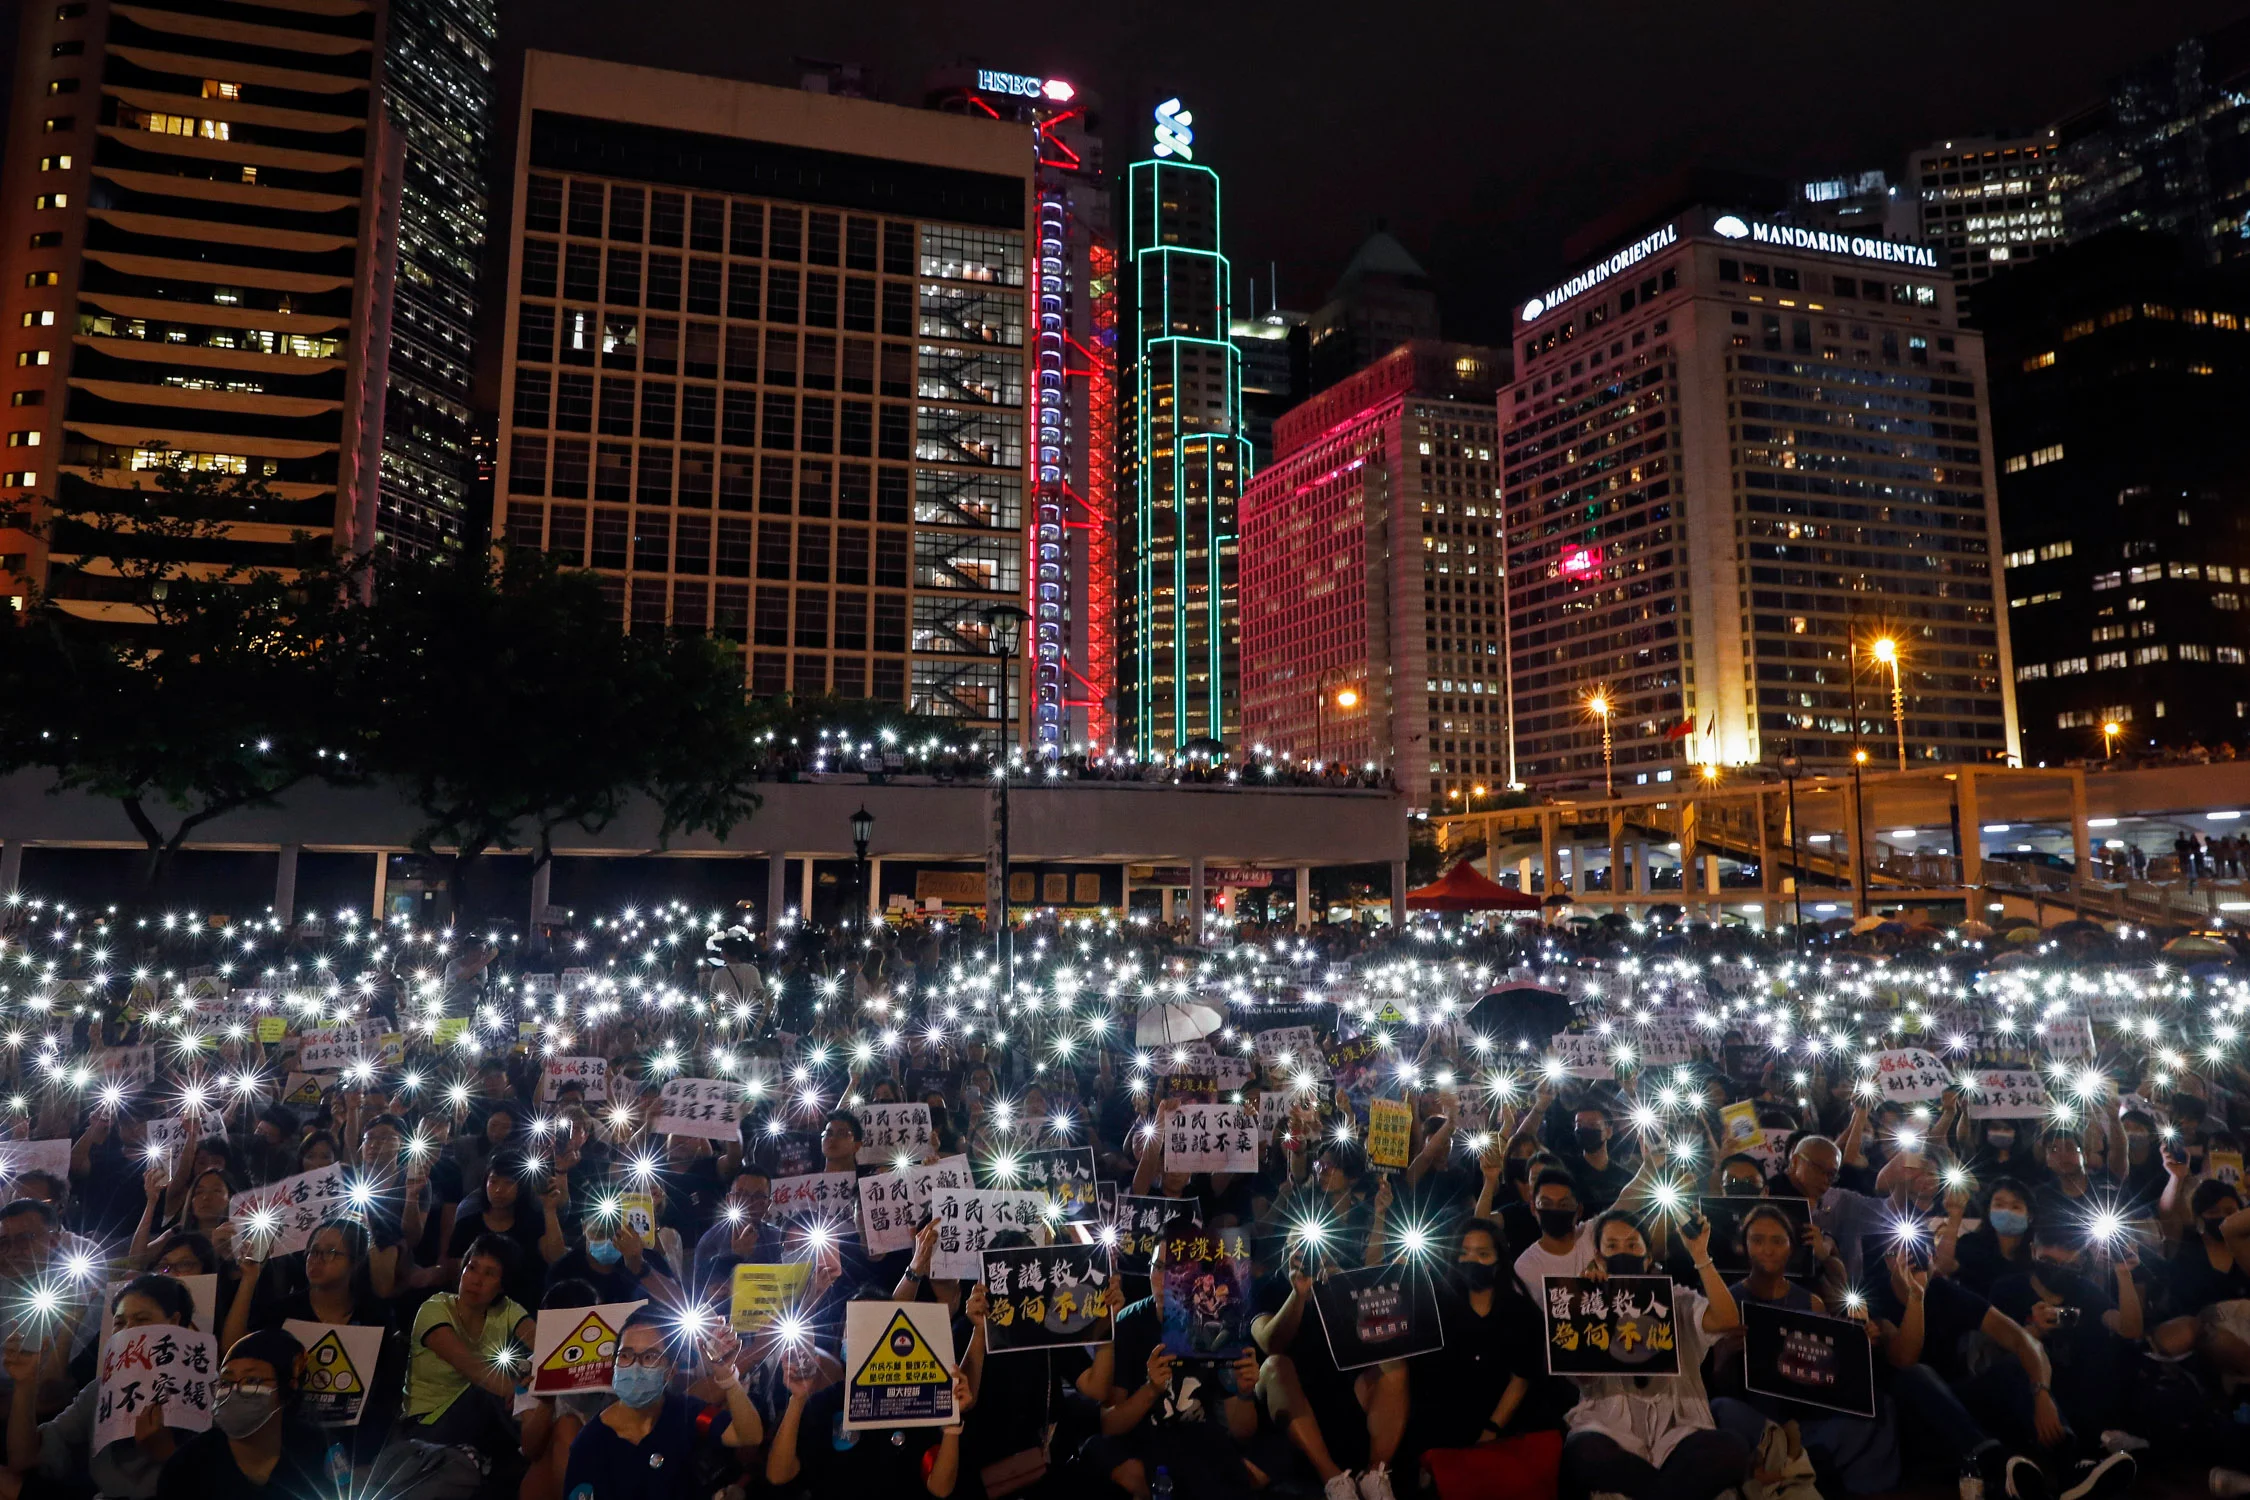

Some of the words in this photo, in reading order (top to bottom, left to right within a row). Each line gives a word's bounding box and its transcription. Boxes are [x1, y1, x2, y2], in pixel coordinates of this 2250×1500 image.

[978, 69, 1041, 98] HSBC
[1753, 222, 1849, 254] MANDARIN
[1851, 237, 1937, 268] ORIENTAL
[1545, 254, 1609, 311] MANDARIN
[1609, 223, 1677, 274] ORIENTAL
[1980, 1074, 2038, 1089] 救香港
[860, 1108, 929, 1127] 市民不離
[1171, 1110, 1254, 1130] 市民不離
[1171, 1130, 1254, 1154] 醫護不棄
[938, 1195, 1040, 1226] 市民不離
[987, 1258, 1107, 1296] 醫護救人
[1549, 1285, 1669, 1320] 醫護救人
[1551, 1320, 1674, 1351] 為何不能
